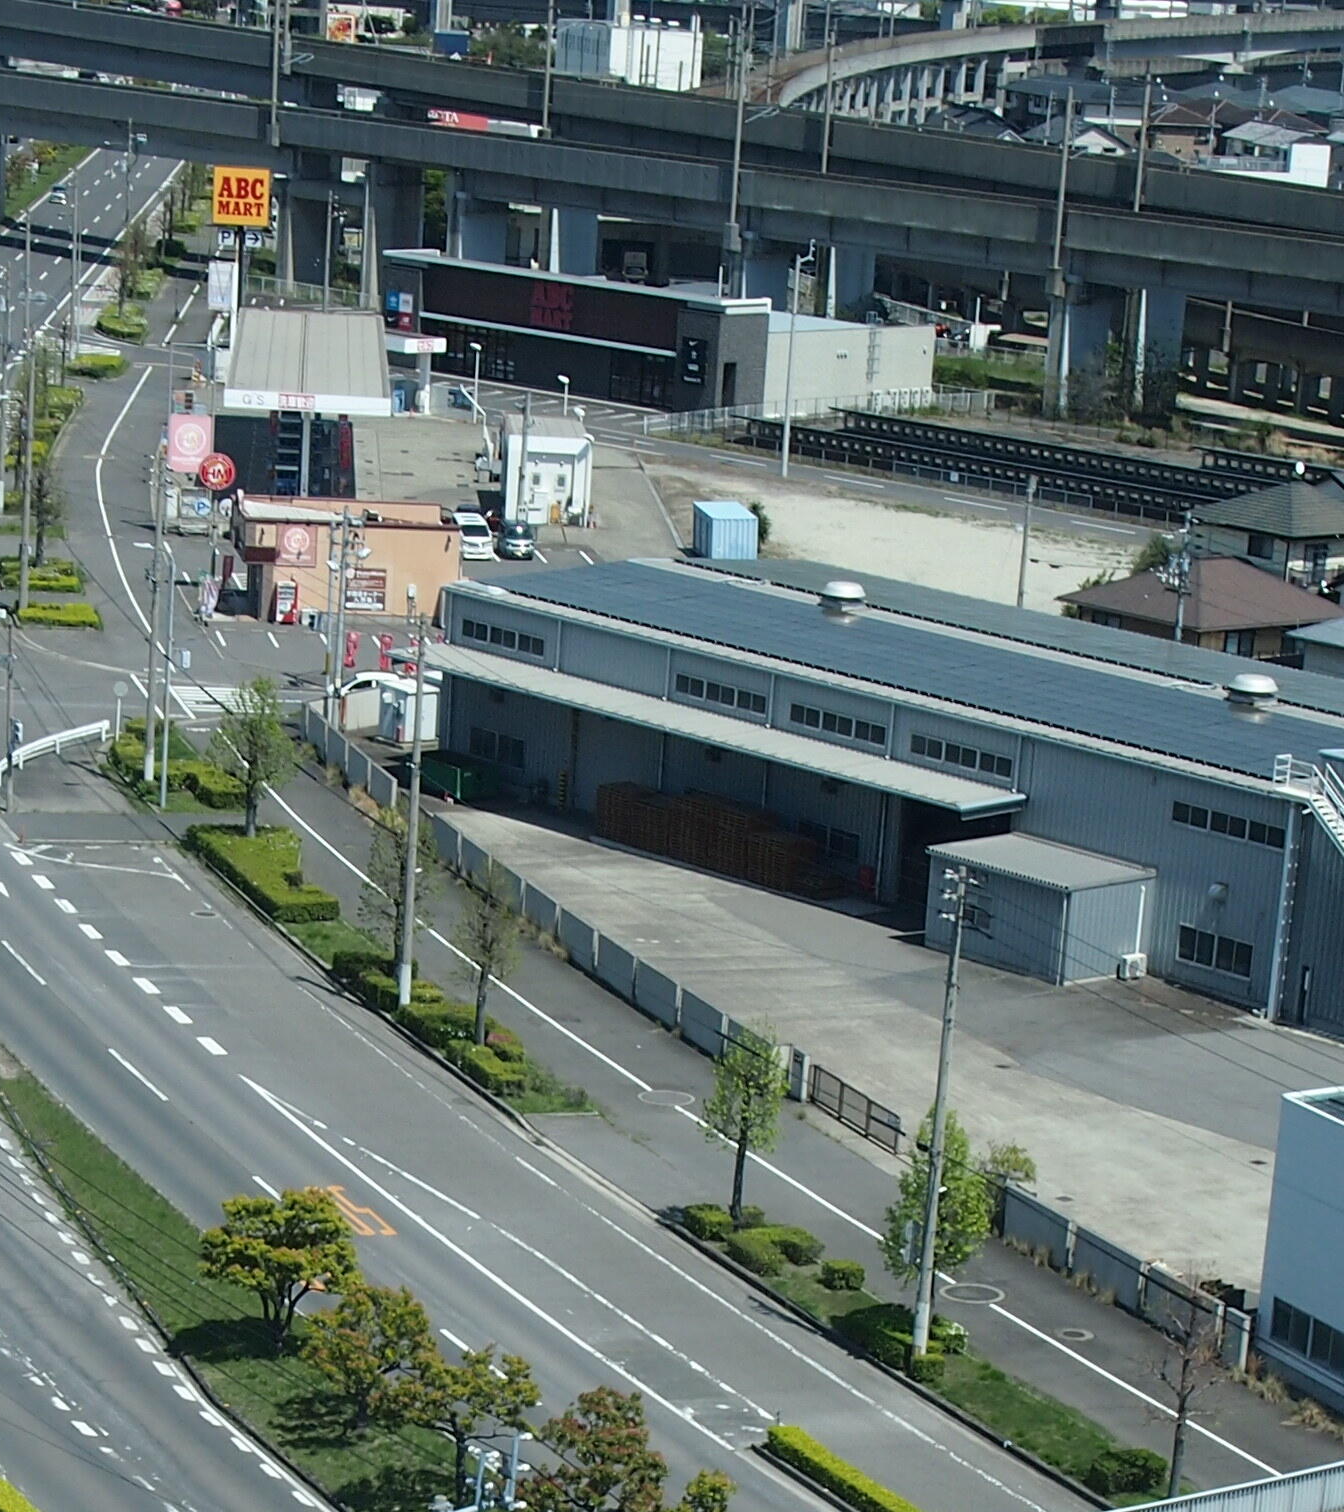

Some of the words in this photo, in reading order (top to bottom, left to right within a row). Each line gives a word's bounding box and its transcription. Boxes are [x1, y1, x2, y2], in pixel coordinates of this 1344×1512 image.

[218, 176, 264, 200] ABC
[217, 200, 264, 217] MART
[221, 230, 231, 244] P
